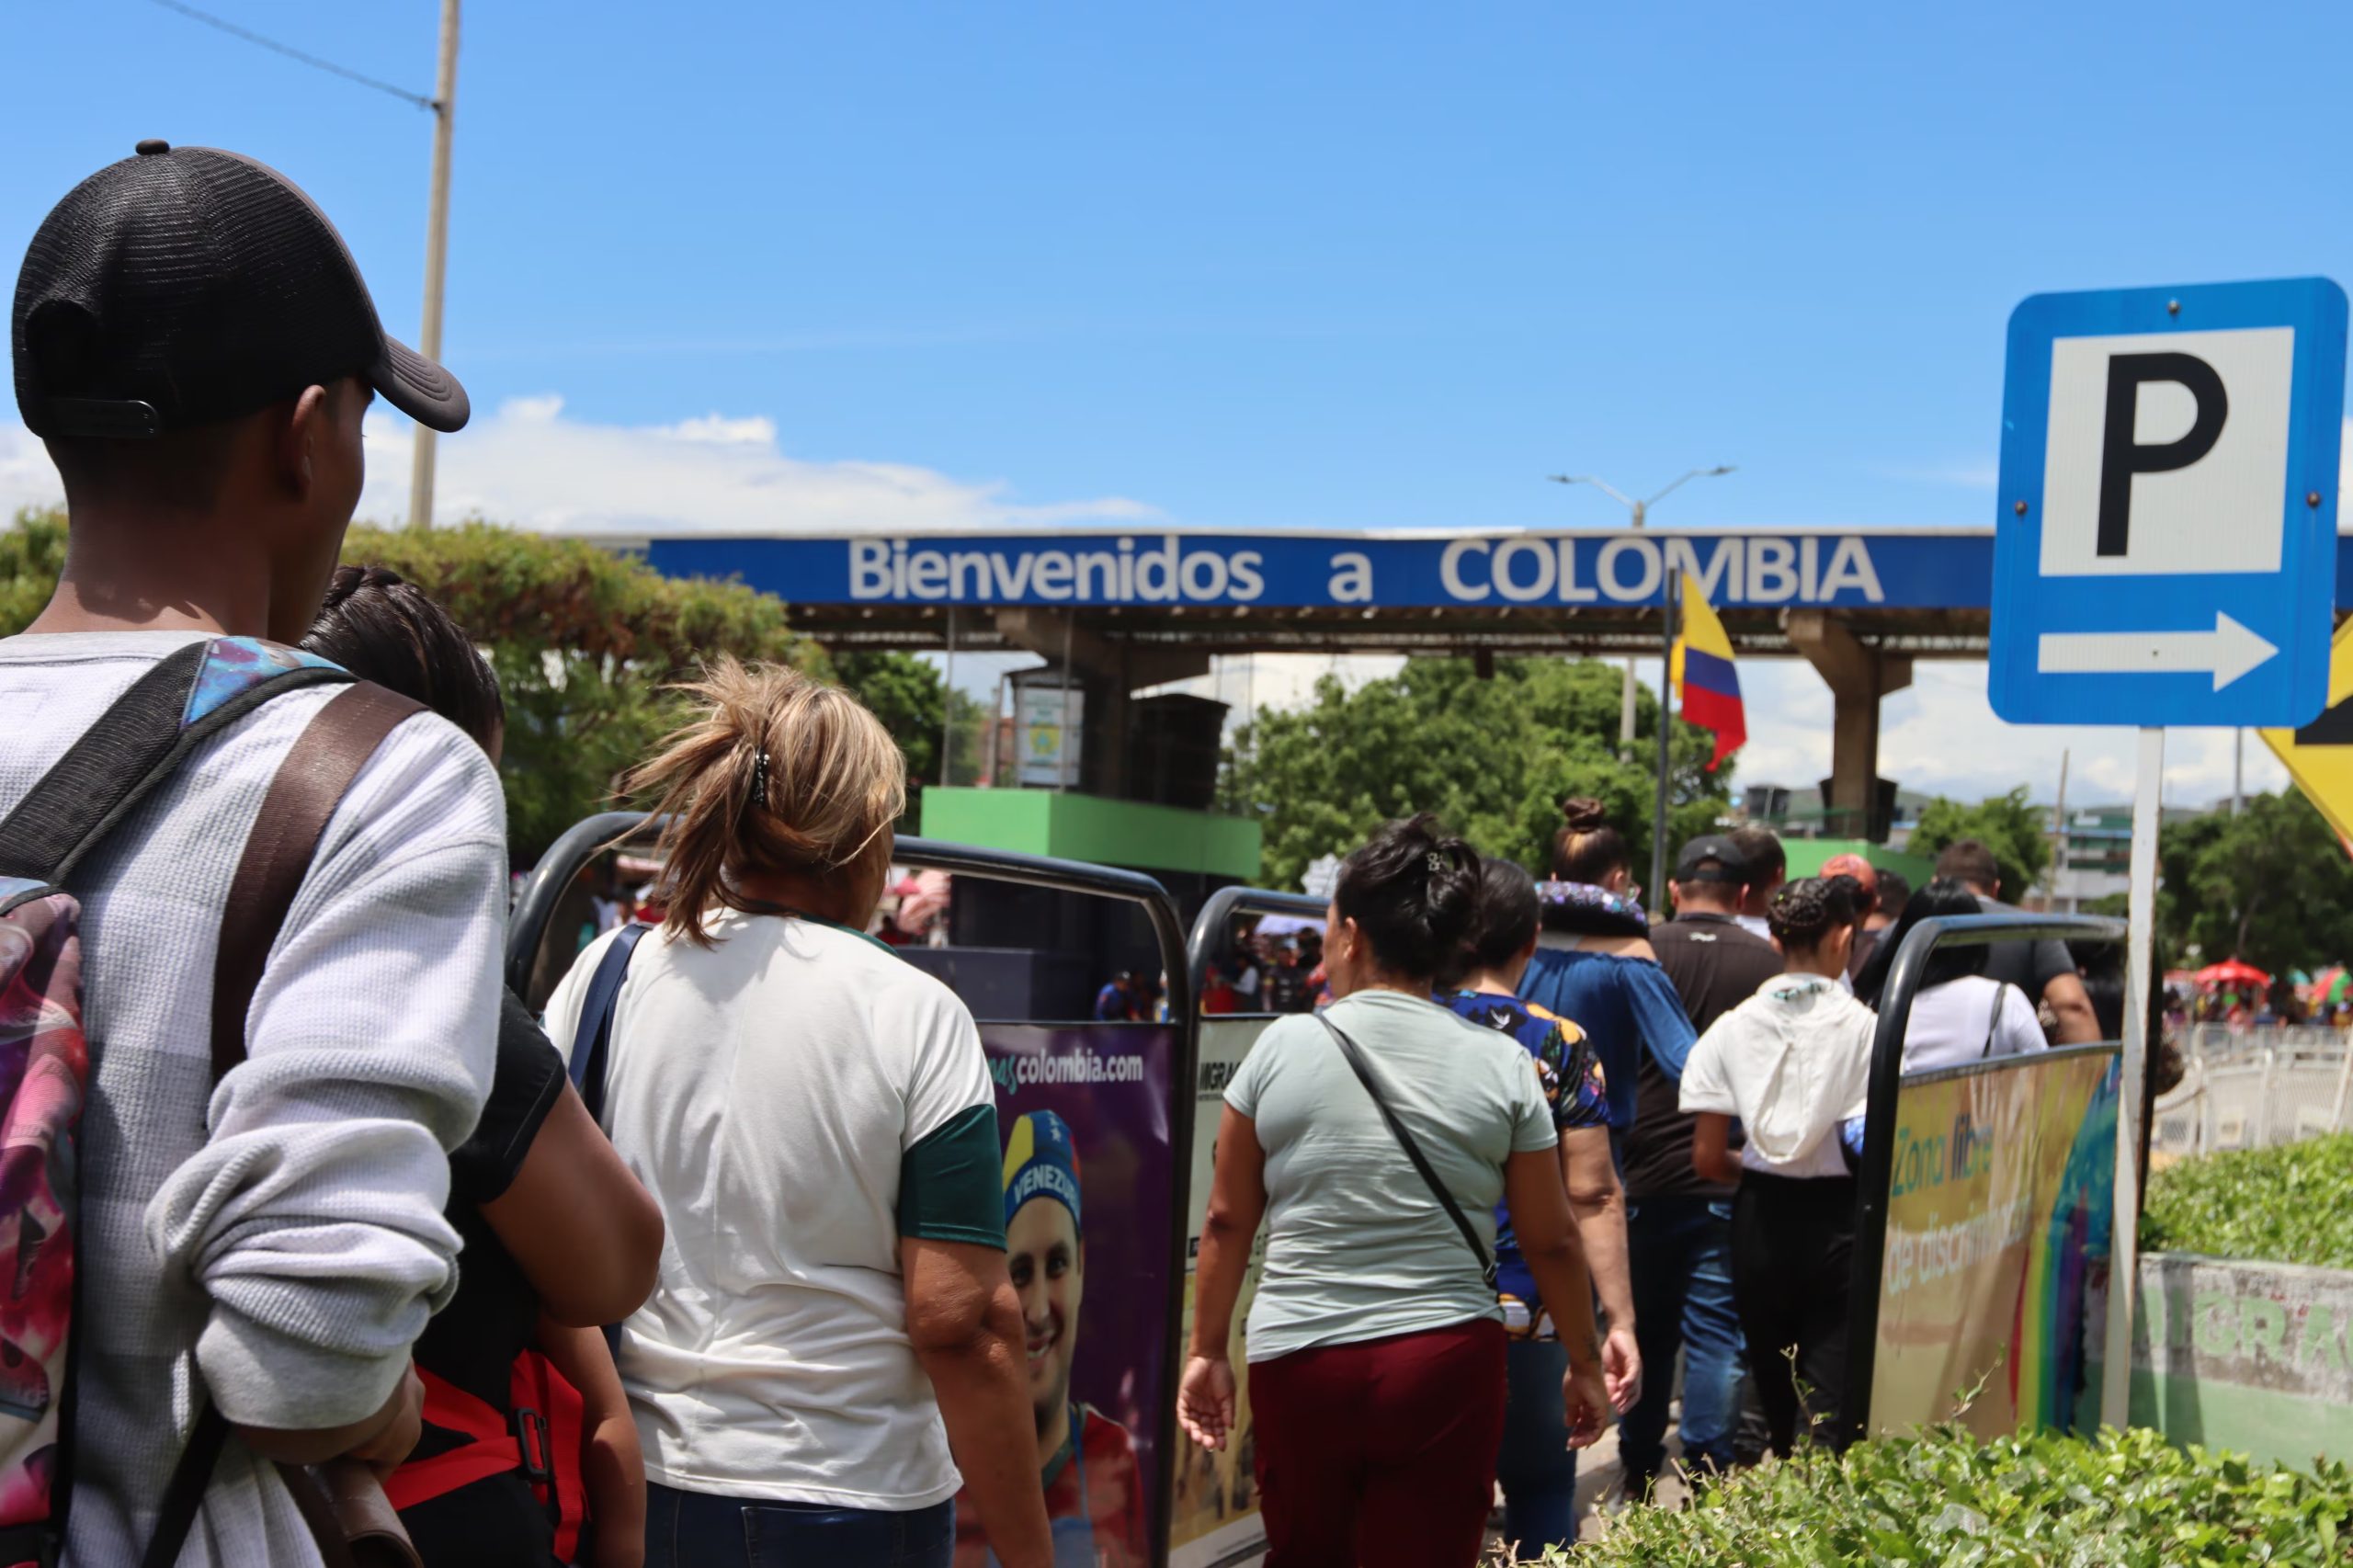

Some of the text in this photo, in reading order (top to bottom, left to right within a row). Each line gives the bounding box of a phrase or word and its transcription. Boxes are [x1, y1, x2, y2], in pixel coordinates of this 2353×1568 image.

[2096, 352, 2229, 557] P
[848, 535, 1884, 603] Bienvenidos a COLOMBIA
[1892, 1125, 1946, 1198] Zona
[1887, 1221, 1914, 1296] de
